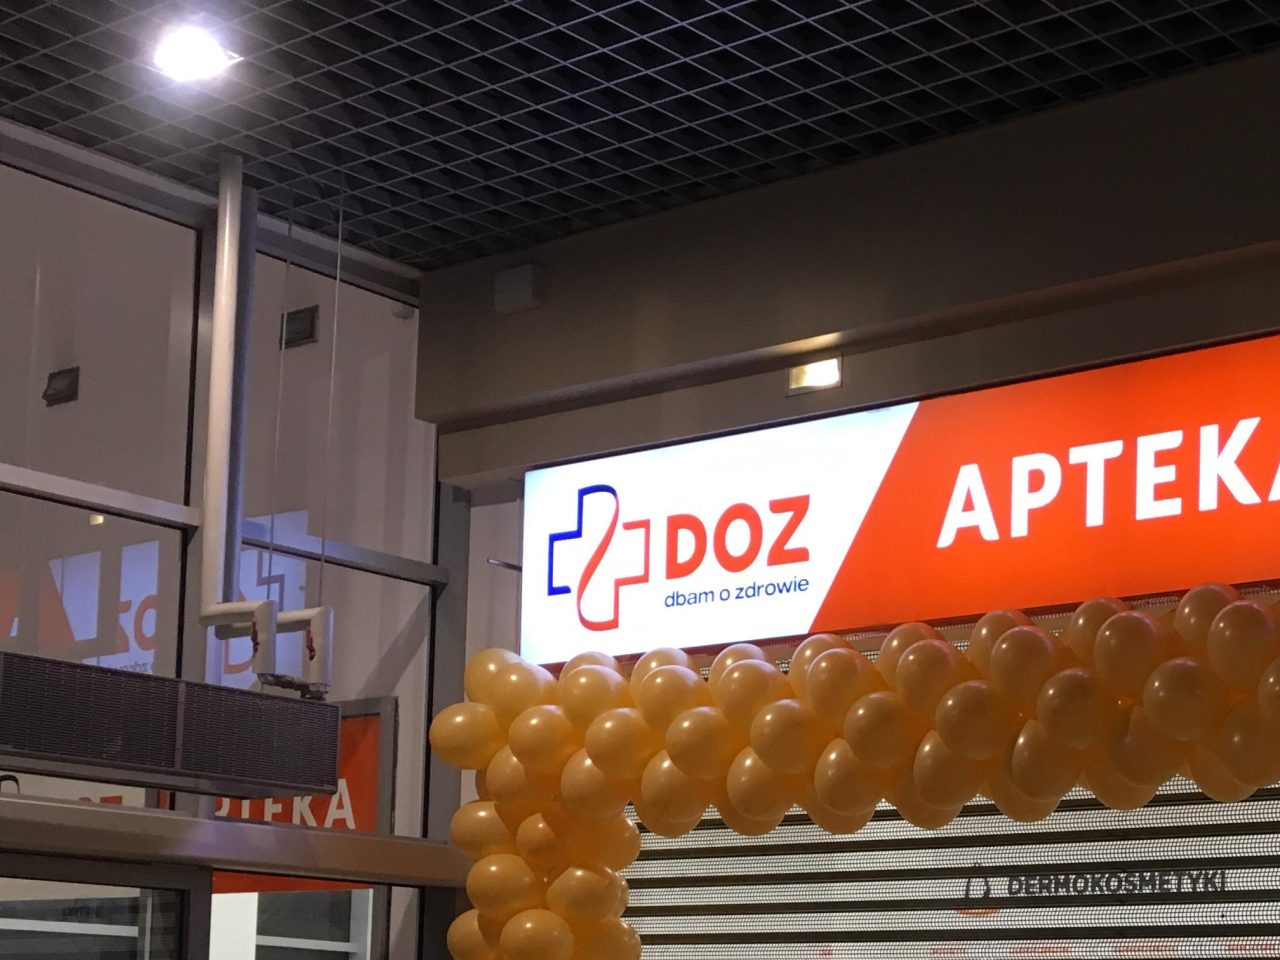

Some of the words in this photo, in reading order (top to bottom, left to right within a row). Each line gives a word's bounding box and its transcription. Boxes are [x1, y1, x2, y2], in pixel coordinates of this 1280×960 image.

[665, 494, 810, 580] DOZ
[664, 588, 714, 608] dbam
[719, 586, 731, 602] o
[735, 575, 810, 600] zdrowie
[1007, 870, 1226, 896] DERMOKOSMETYKI
